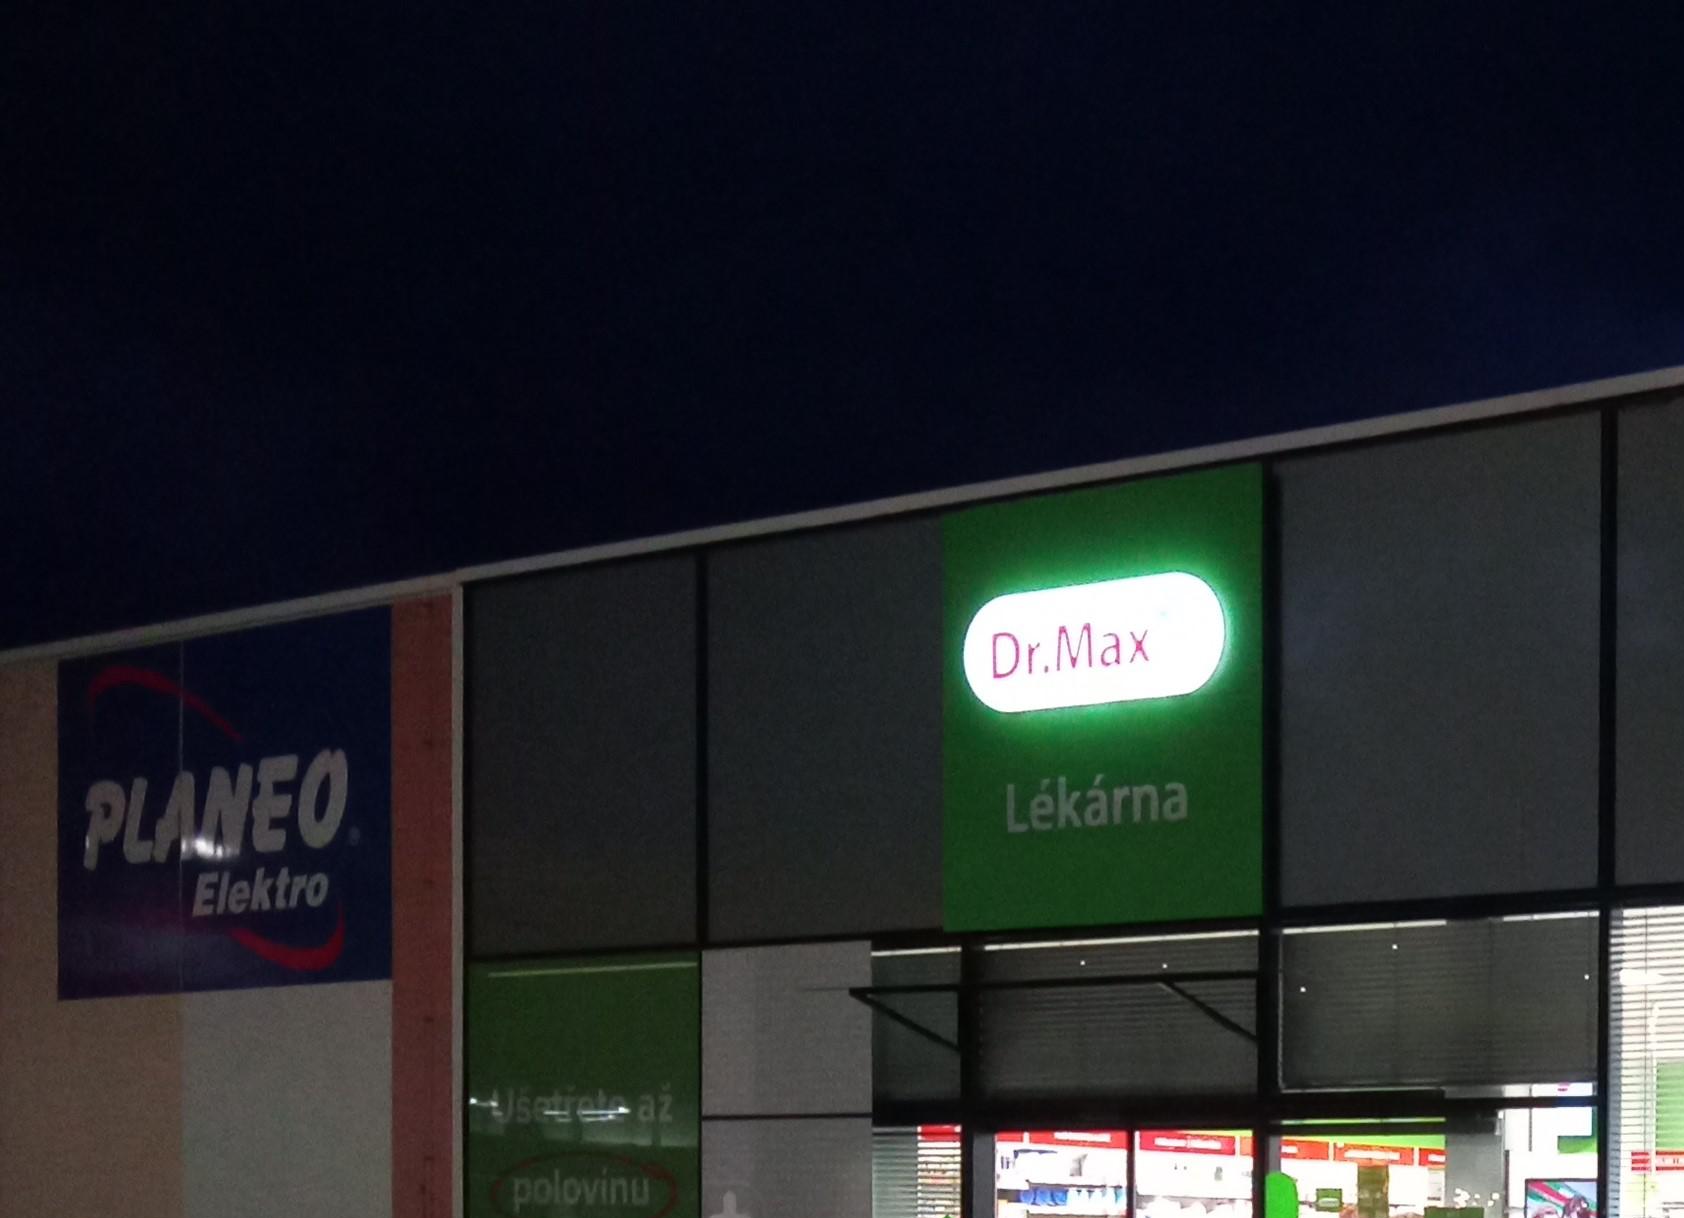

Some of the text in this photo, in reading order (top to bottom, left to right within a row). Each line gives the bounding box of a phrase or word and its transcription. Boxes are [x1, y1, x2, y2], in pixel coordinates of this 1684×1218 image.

[991, 622, 1150, 679] Dr.Max
[83, 748, 348, 871] PLANEO
[1006, 774, 1189, 833] Lékárna
[192, 867, 329, 917] Elektro
[637, 1082, 674, 1124] až
[512, 1167, 651, 1214] polovinu
